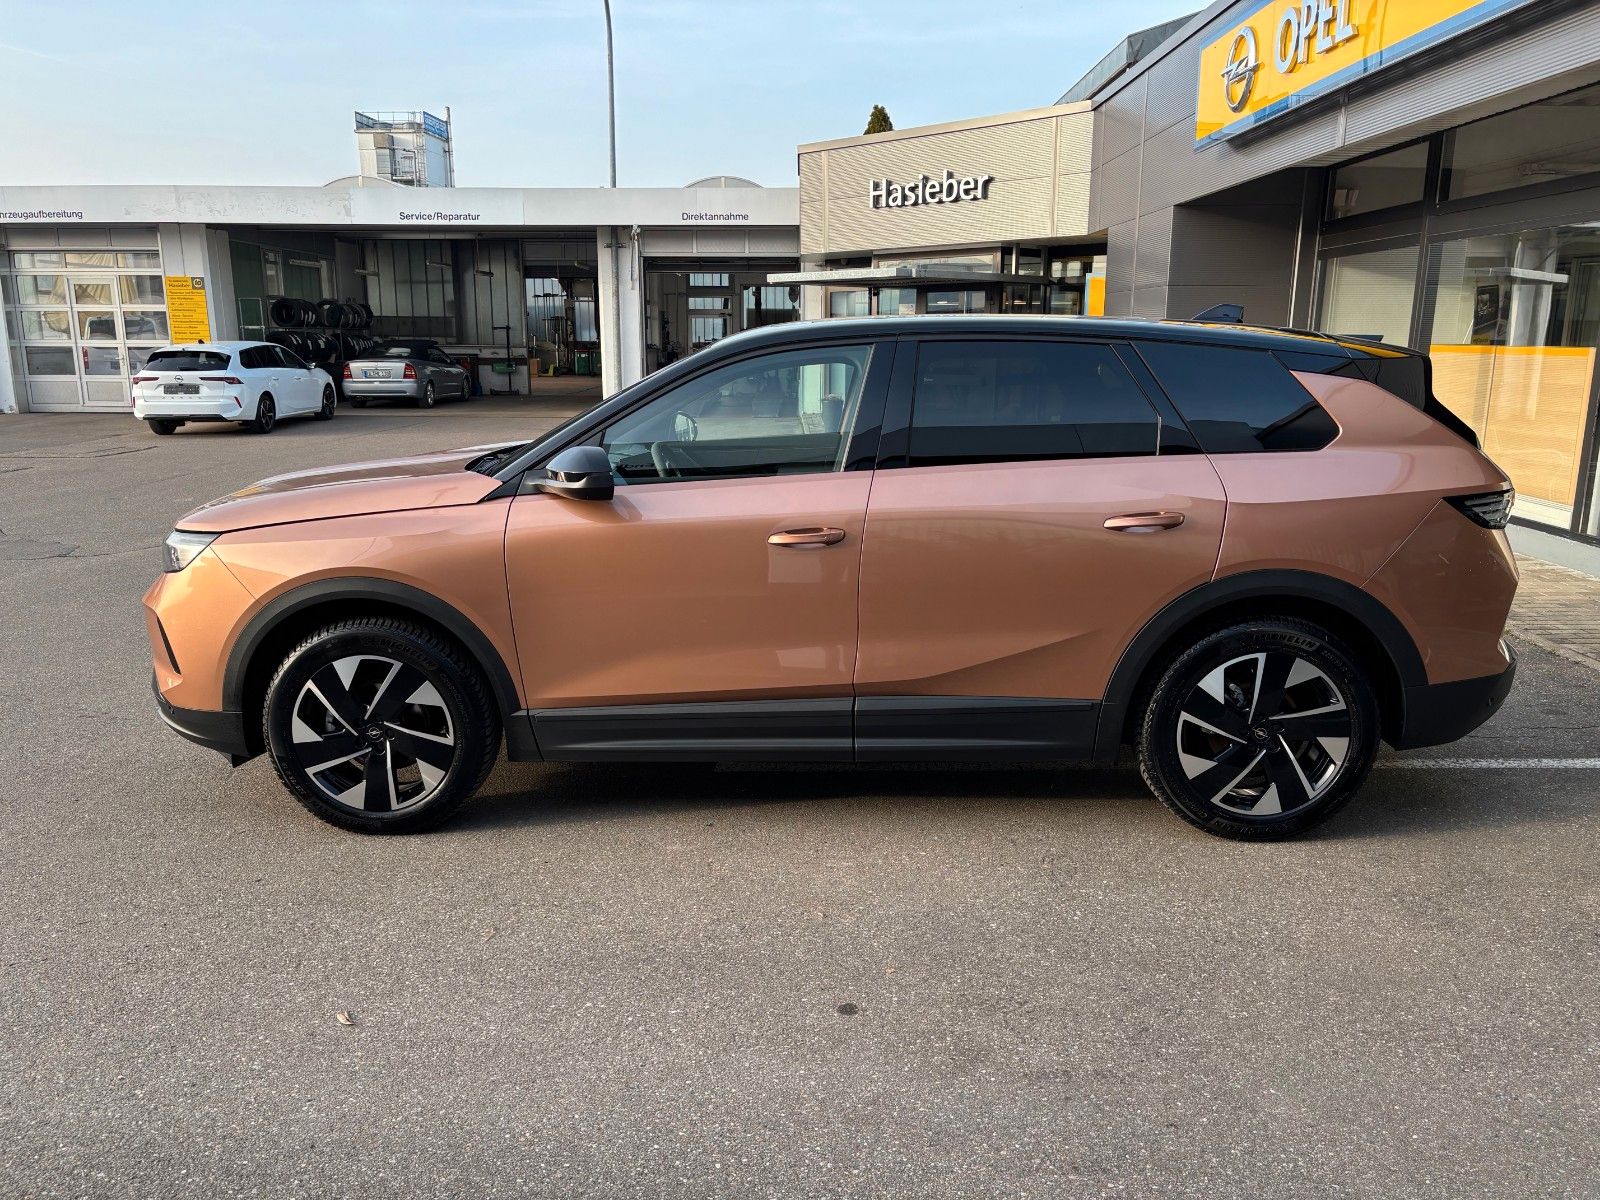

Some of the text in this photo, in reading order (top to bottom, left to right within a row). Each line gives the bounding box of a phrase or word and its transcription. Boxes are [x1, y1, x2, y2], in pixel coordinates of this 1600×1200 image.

[1276, 0, 1359, 74] OPEL
[869, 169, 989, 208] Hasieber
[399, 211, 481, 222] Service/Reparatur
[681, 212, 749, 221] Direktannahme
